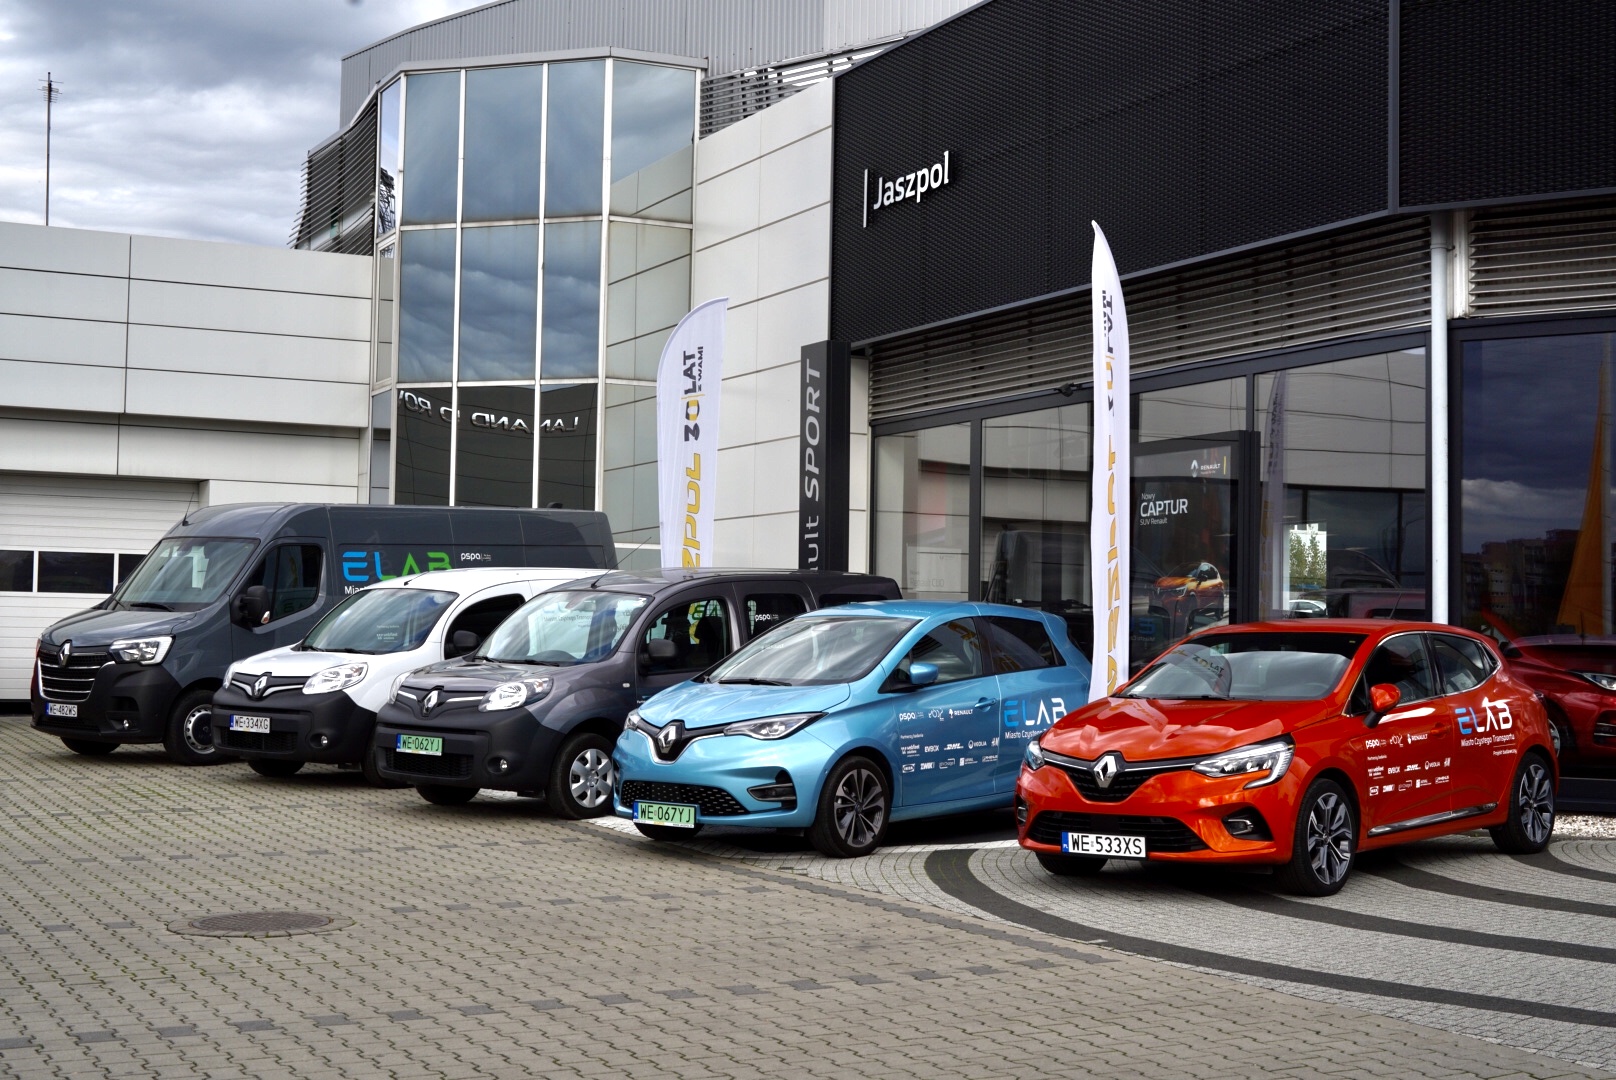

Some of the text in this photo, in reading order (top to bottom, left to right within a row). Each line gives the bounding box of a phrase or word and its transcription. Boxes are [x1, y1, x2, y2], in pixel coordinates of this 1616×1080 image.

[873, 150, 949, 210] Jaszpol
[804, 358, 820, 502] SPORT
[1141, 493, 1155, 501] Nowy
[1140, 498, 1188, 517] CAPTUR
[1140, 517, 1168, 526] SUV Renault
[460, 552, 481, 561] pspa
[342, 551, 454, 582] ELAB
[755, 613, 771, 622] pspa
[899, 712, 916, 722] pspa
[953, 708, 974, 716] RENAULT
[1004, 697, 1068, 728] ELAB
[1454, 701, 1513, 735] ELAB
[234, 716, 269, 730] WE 334XG
[1004, 731, 1021, 740] Miasto
[1411, 733, 1428, 742] RENAULT
[1460, 733, 1516, 747] Miasto Czystego Transportu
[402, 736, 440, 751] WE 062YJ
[1365, 739, 1380, 750] pspa
[640, 804, 691, 823] WE 067YJ
[1071, 834, 1142, 855] WE 533XS
